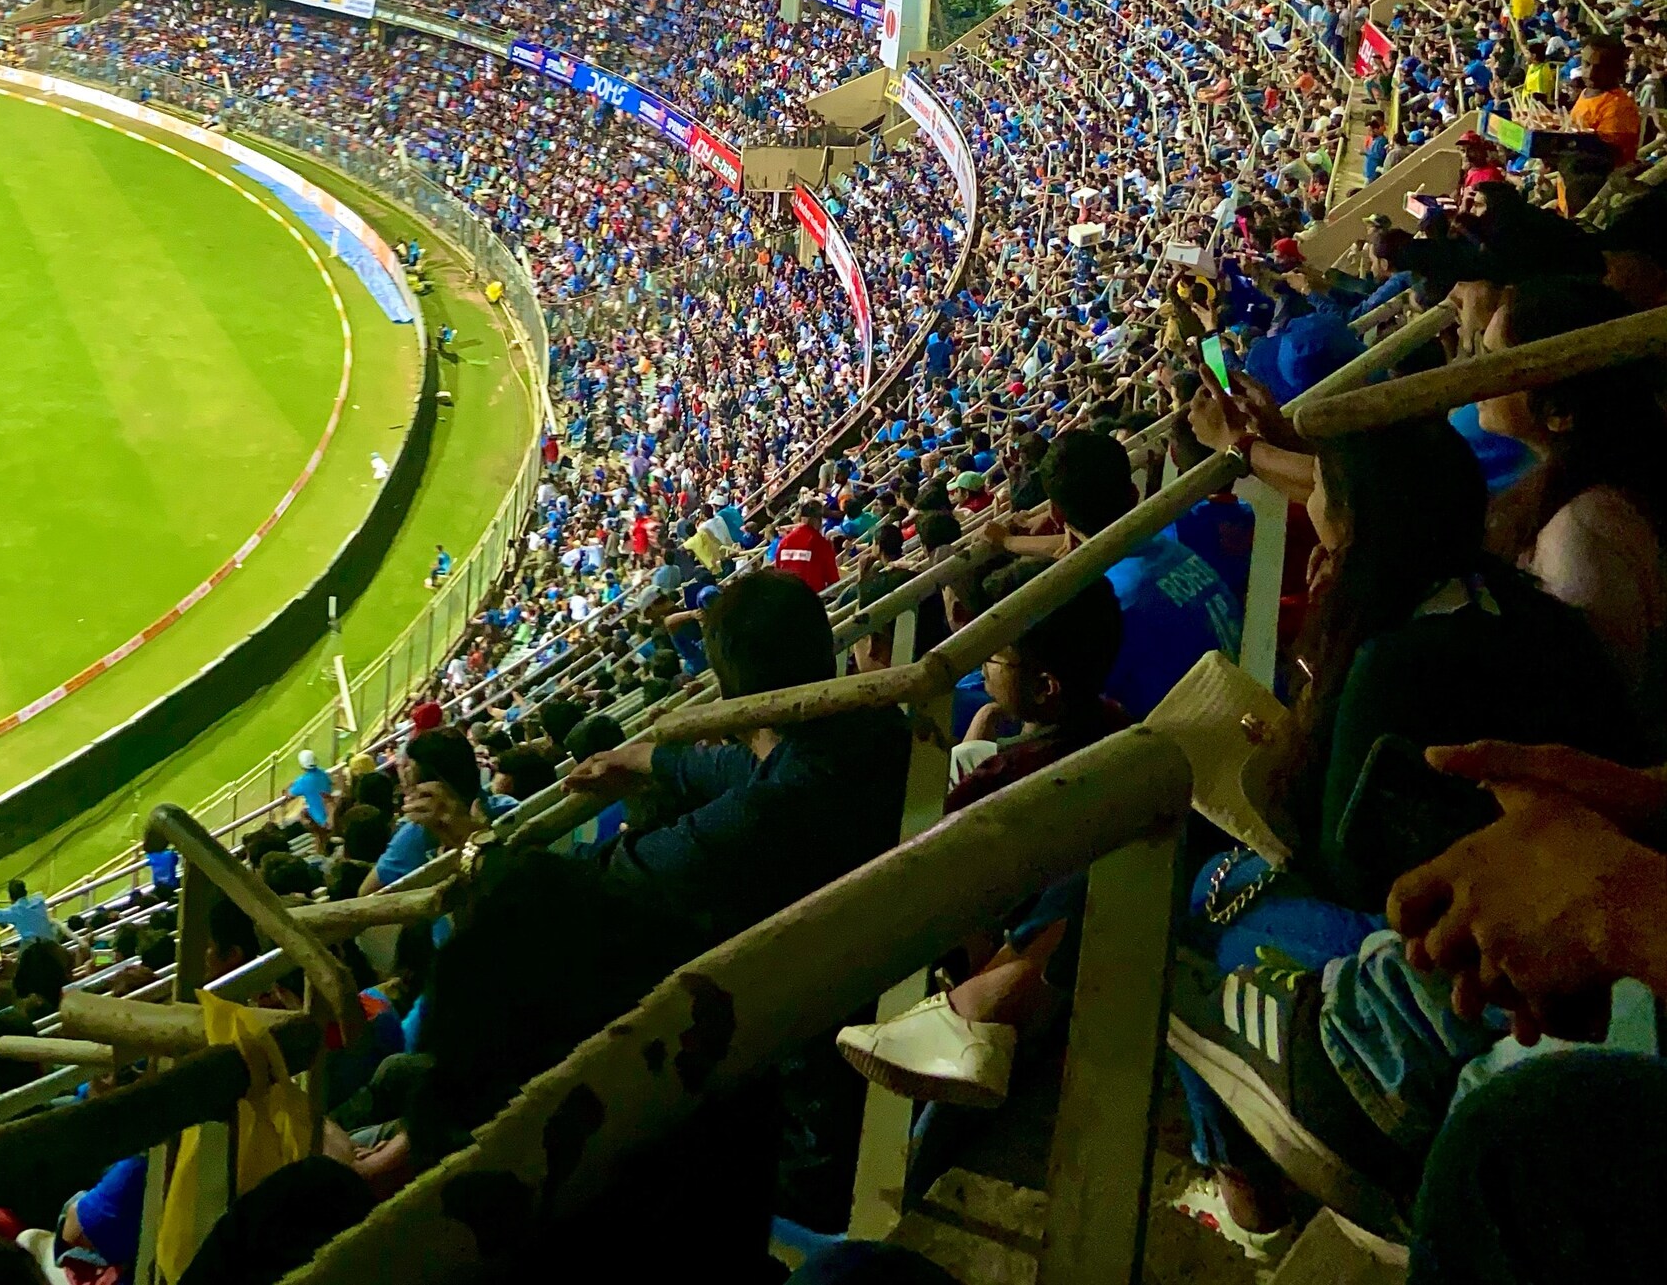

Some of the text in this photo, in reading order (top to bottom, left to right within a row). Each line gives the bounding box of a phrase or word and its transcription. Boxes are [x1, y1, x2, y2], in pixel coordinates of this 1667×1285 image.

[586, 70, 630, 106] DOMS
[690, 137, 738, 185] JOY e-bike
